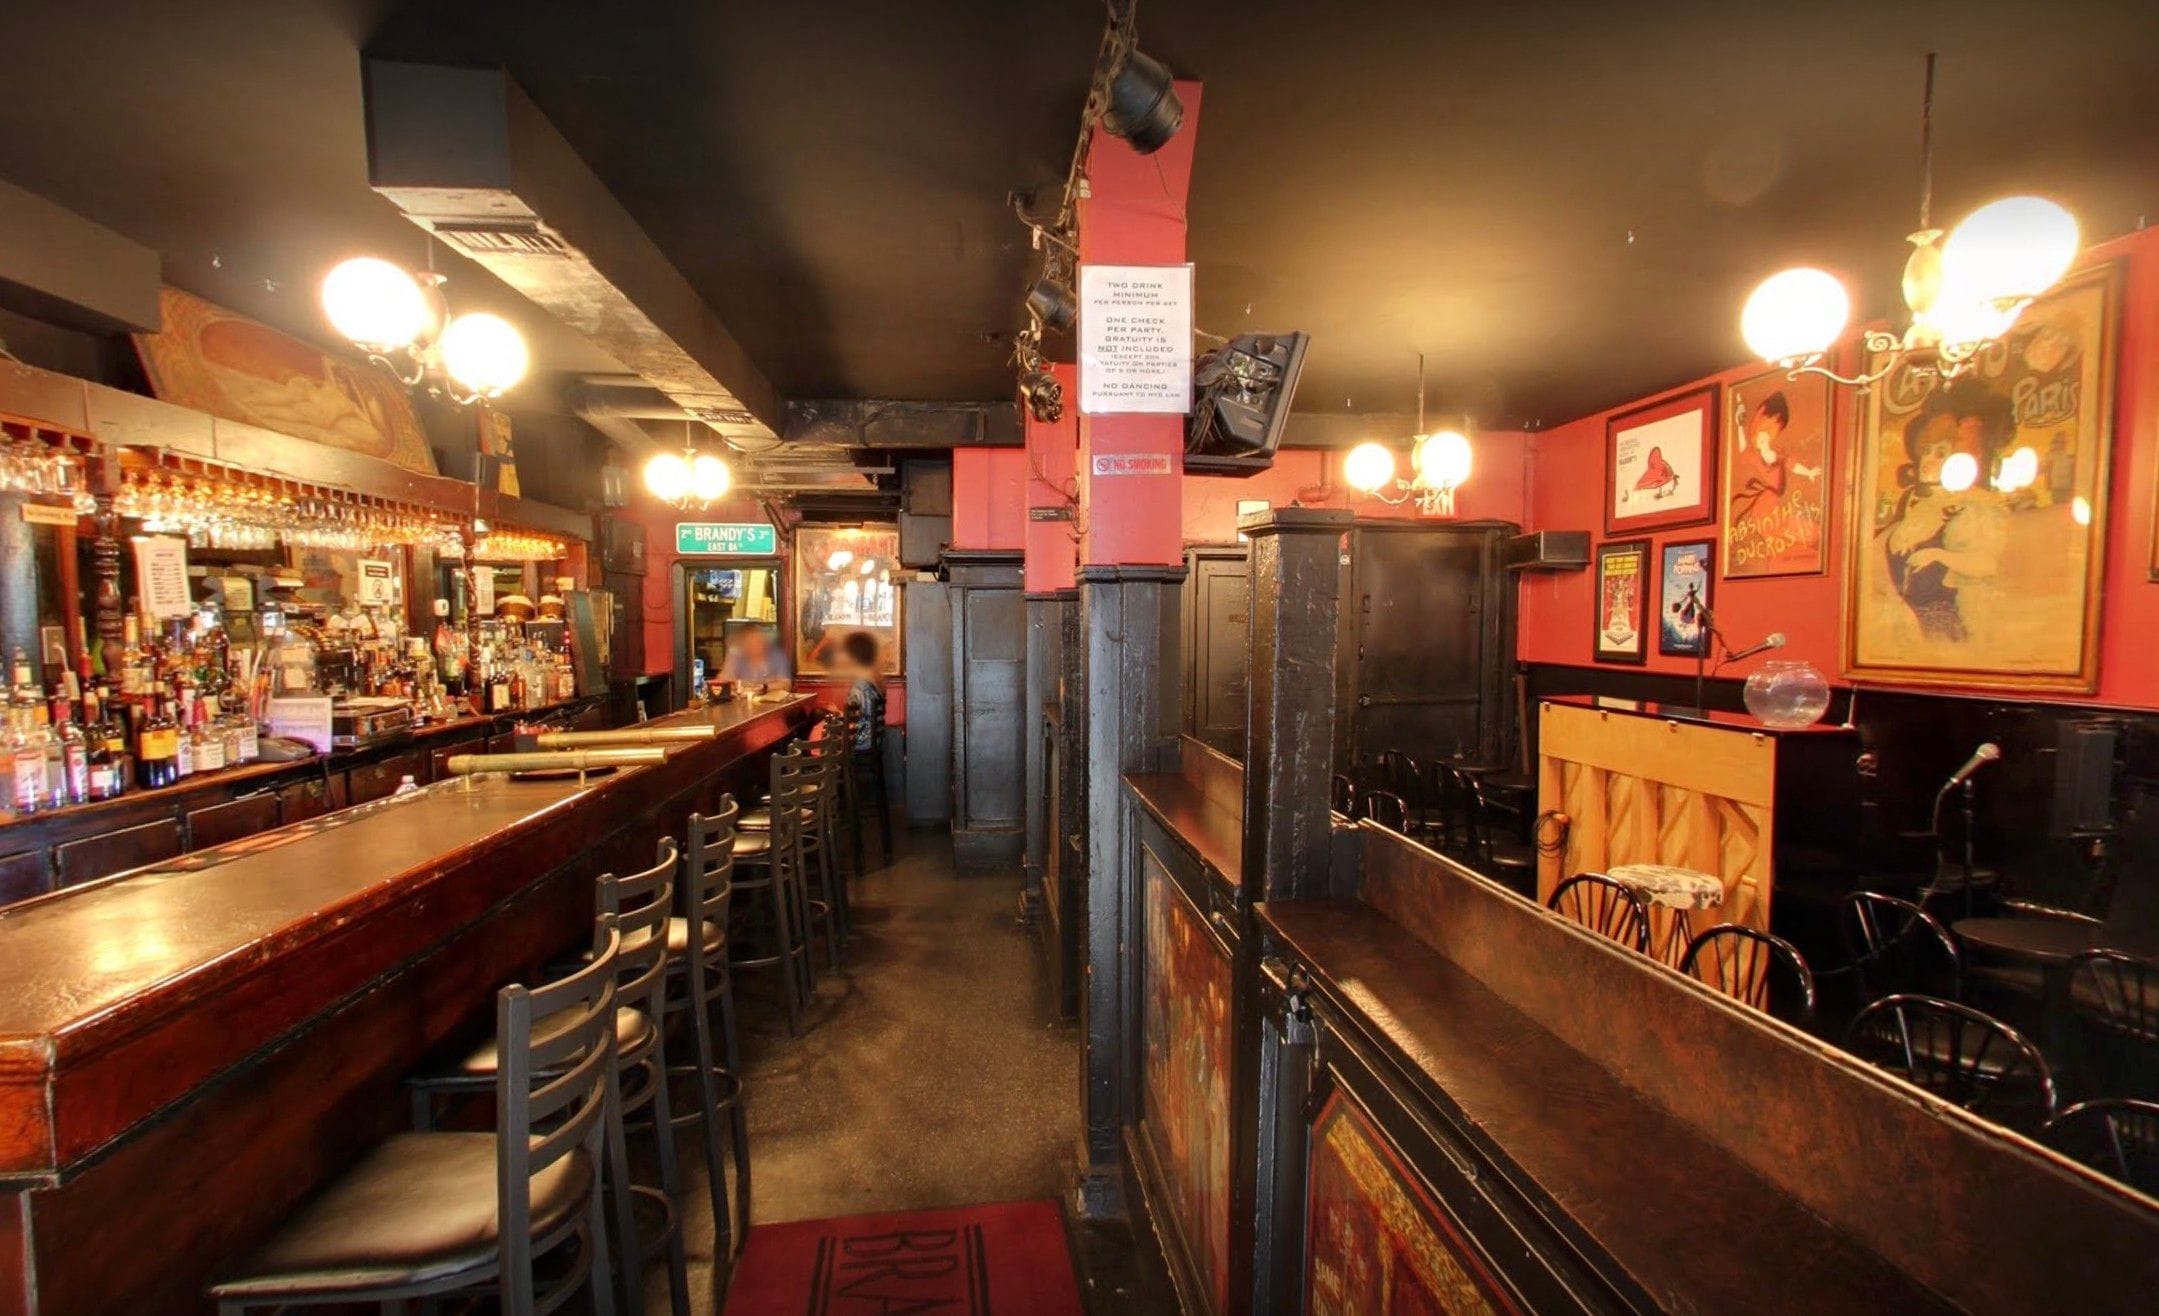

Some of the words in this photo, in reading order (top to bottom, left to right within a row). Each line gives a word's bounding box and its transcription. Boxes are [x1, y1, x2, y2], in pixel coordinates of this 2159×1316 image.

[1114, 458, 1126, 470] NO
[1127, 458, 1166, 470] SMOKING
[694, 527, 756, 542] BRANDY'S
[708, 542, 726, 552] EAST
